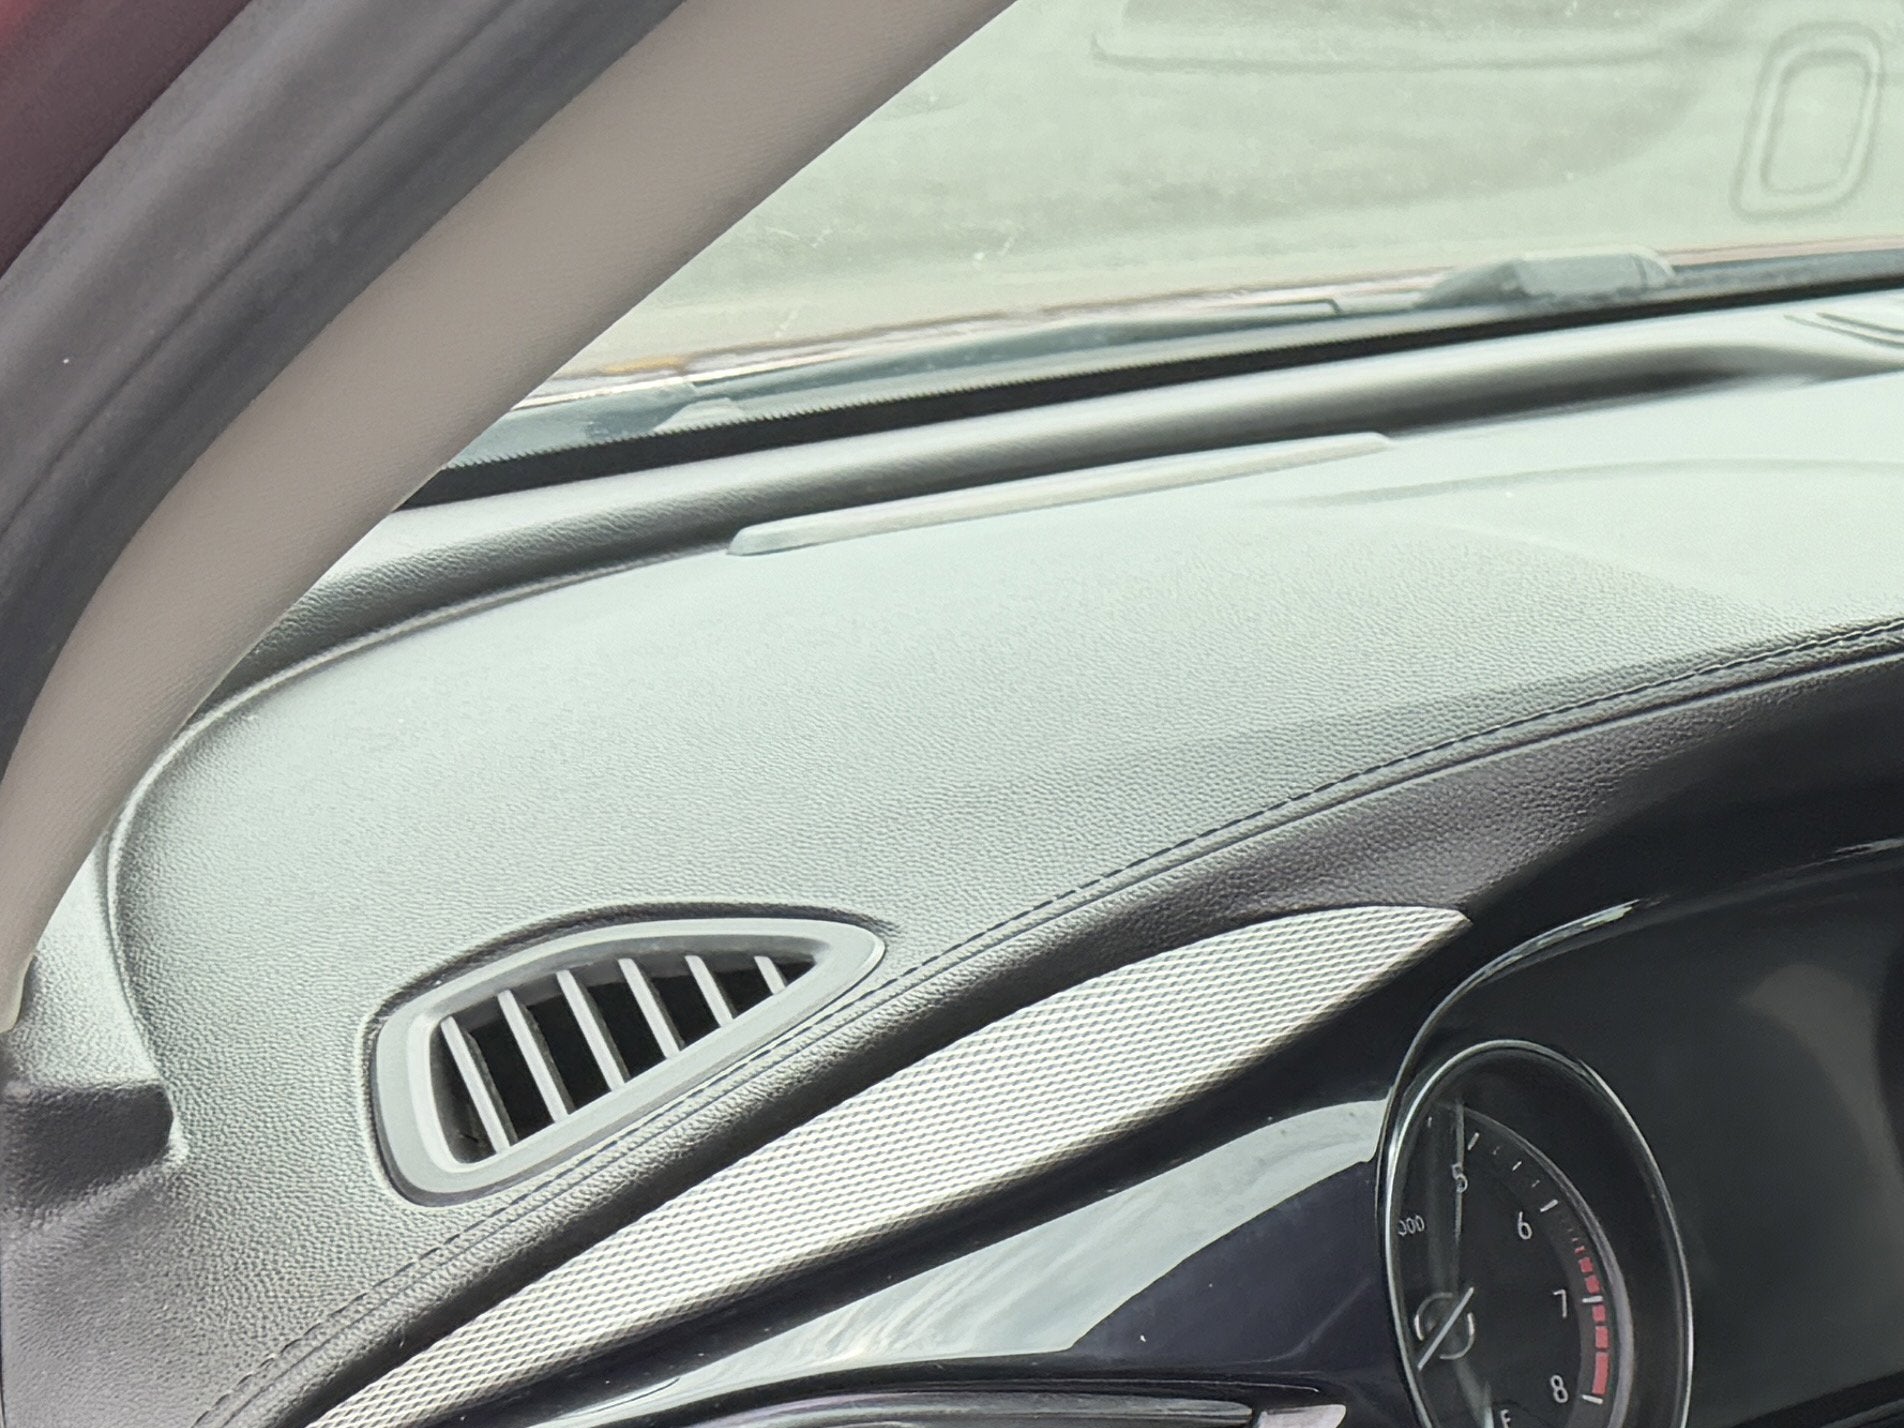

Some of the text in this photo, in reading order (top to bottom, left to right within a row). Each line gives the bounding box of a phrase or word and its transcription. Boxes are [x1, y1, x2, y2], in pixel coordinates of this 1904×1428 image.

[1451, 1163, 1469, 1194] 5
[1517, 1210, 1533, 1241] 6
[1552, 1288, 1568, 1319] 7
[1550, 1374, 1569, 1404] 8
